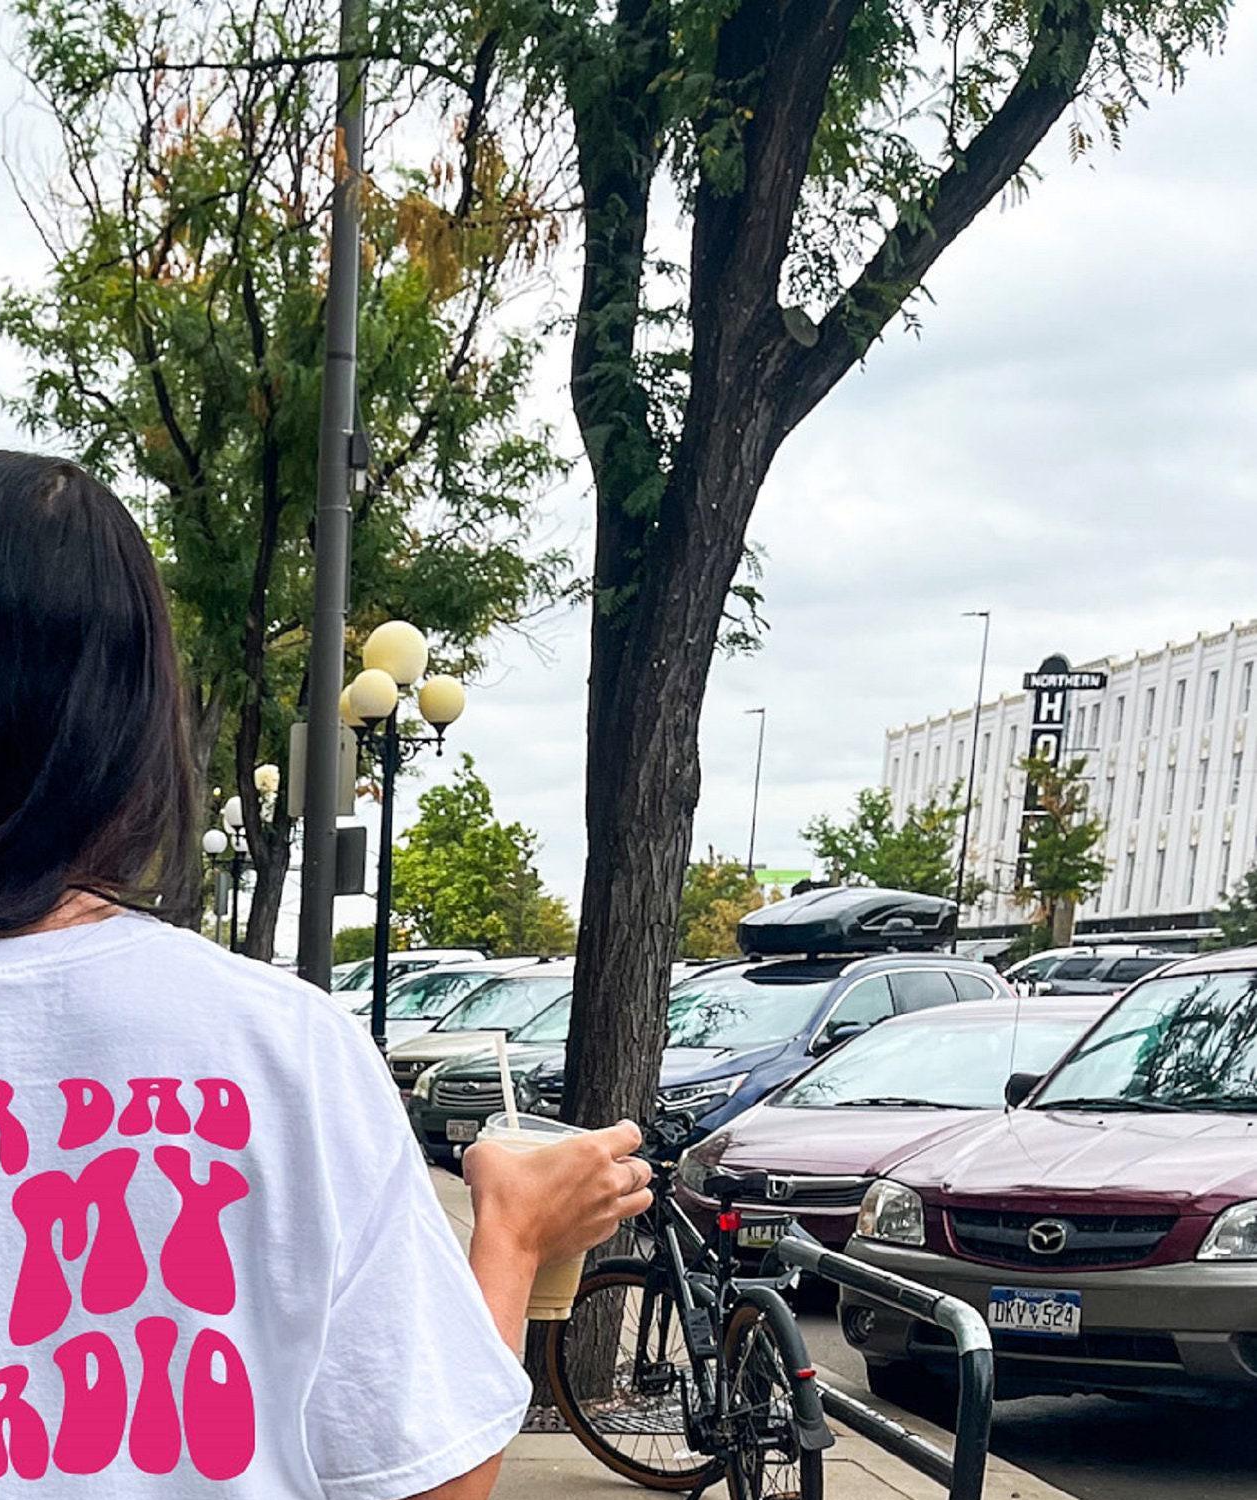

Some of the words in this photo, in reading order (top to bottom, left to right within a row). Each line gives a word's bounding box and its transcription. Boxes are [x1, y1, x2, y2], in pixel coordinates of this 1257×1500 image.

[1030, 673, 1102, 689] NORTHERN
[58, 1078, 251, 1150] DAD
[9, 1145, 250, 1346] MY
[994, 1301, 1027, 1325] DKV
[1042, 1303, 1073, 1327] 524
